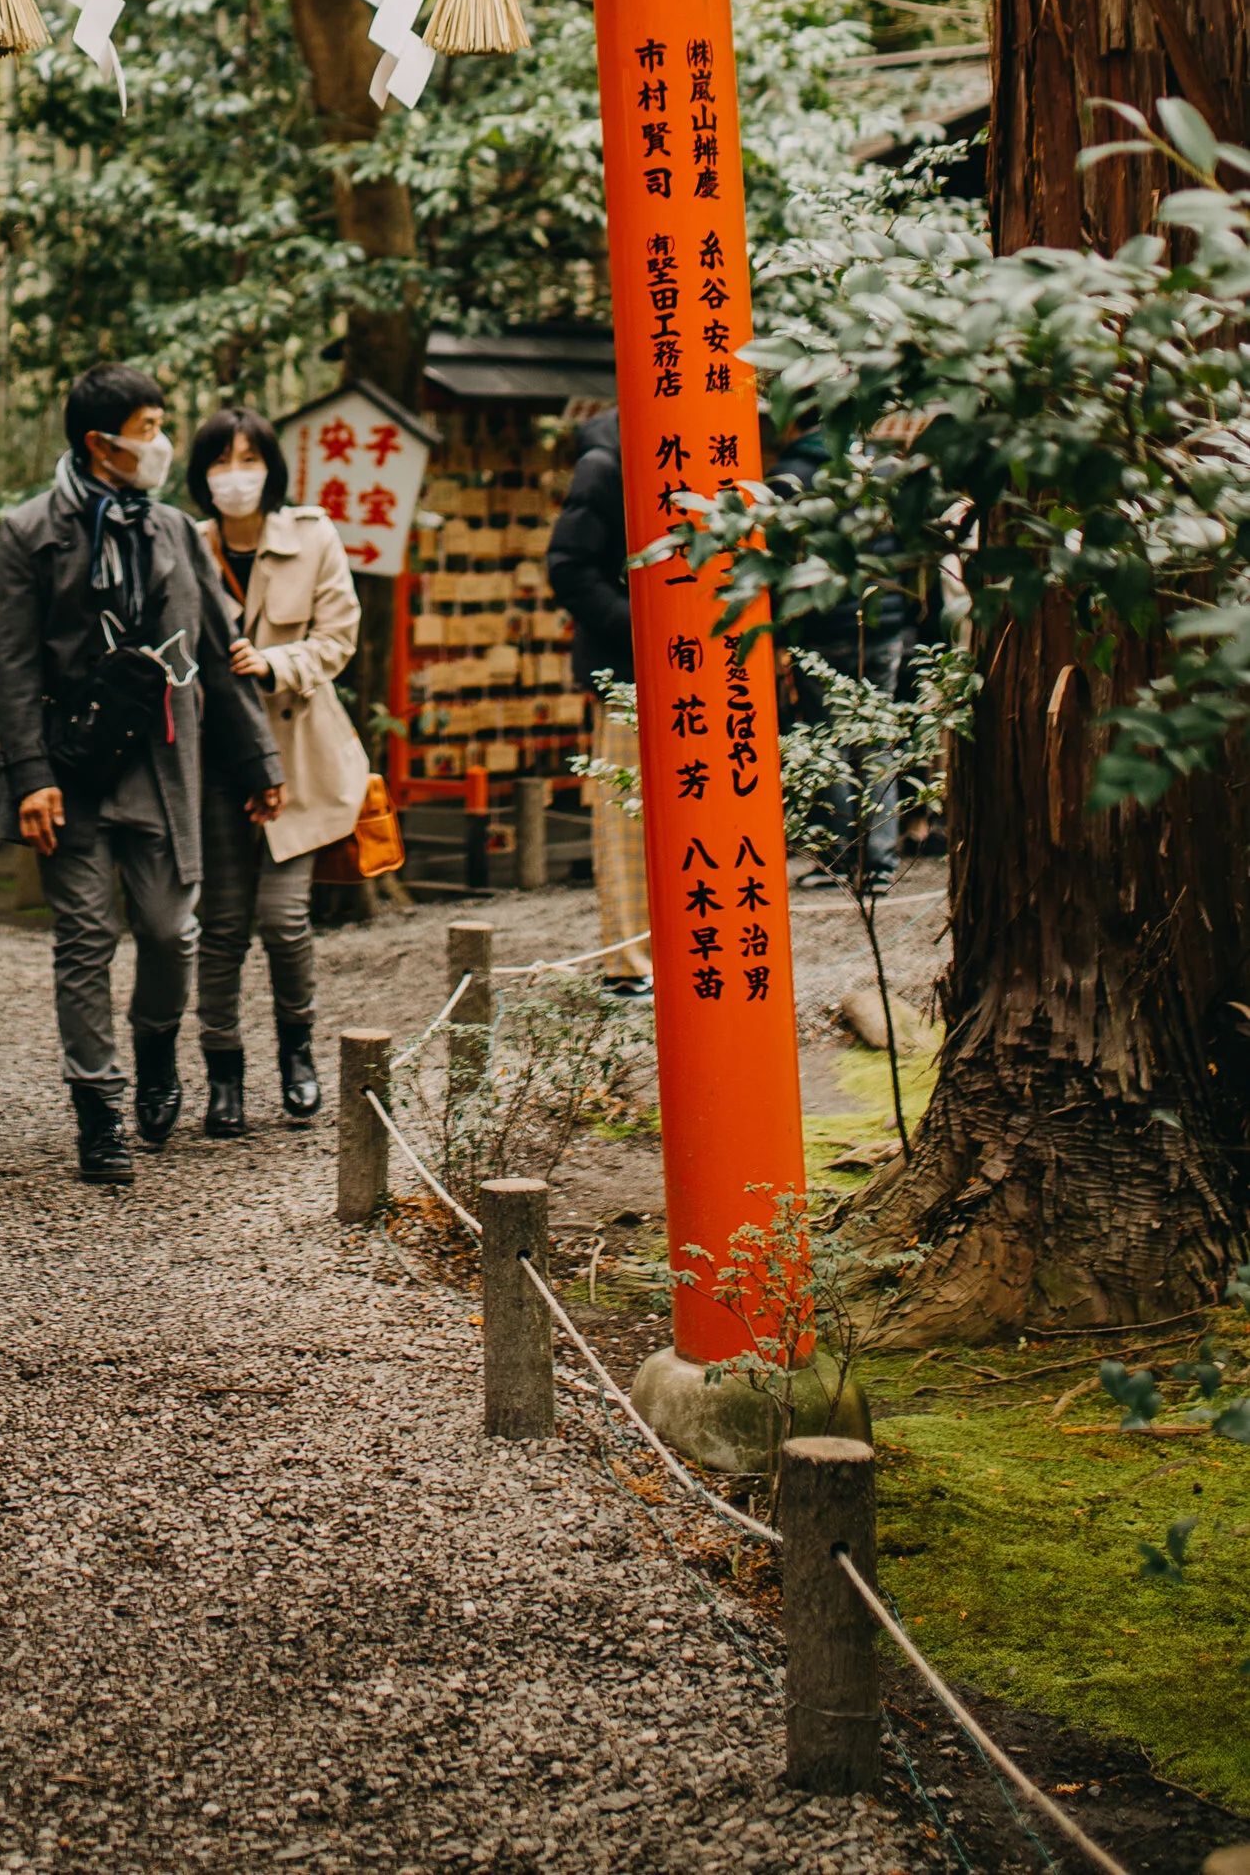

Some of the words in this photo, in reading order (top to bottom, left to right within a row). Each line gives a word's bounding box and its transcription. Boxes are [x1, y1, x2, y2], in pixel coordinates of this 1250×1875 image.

[359, 424, 401, 530] 子宝
[634, 38, 673, 199] 市村賢司
[681, 837, 726, 1001] 八木早苗
[698, 229, 732, 394] 糸谷安雄
[734, 835, 771, 1002] 八木治男
